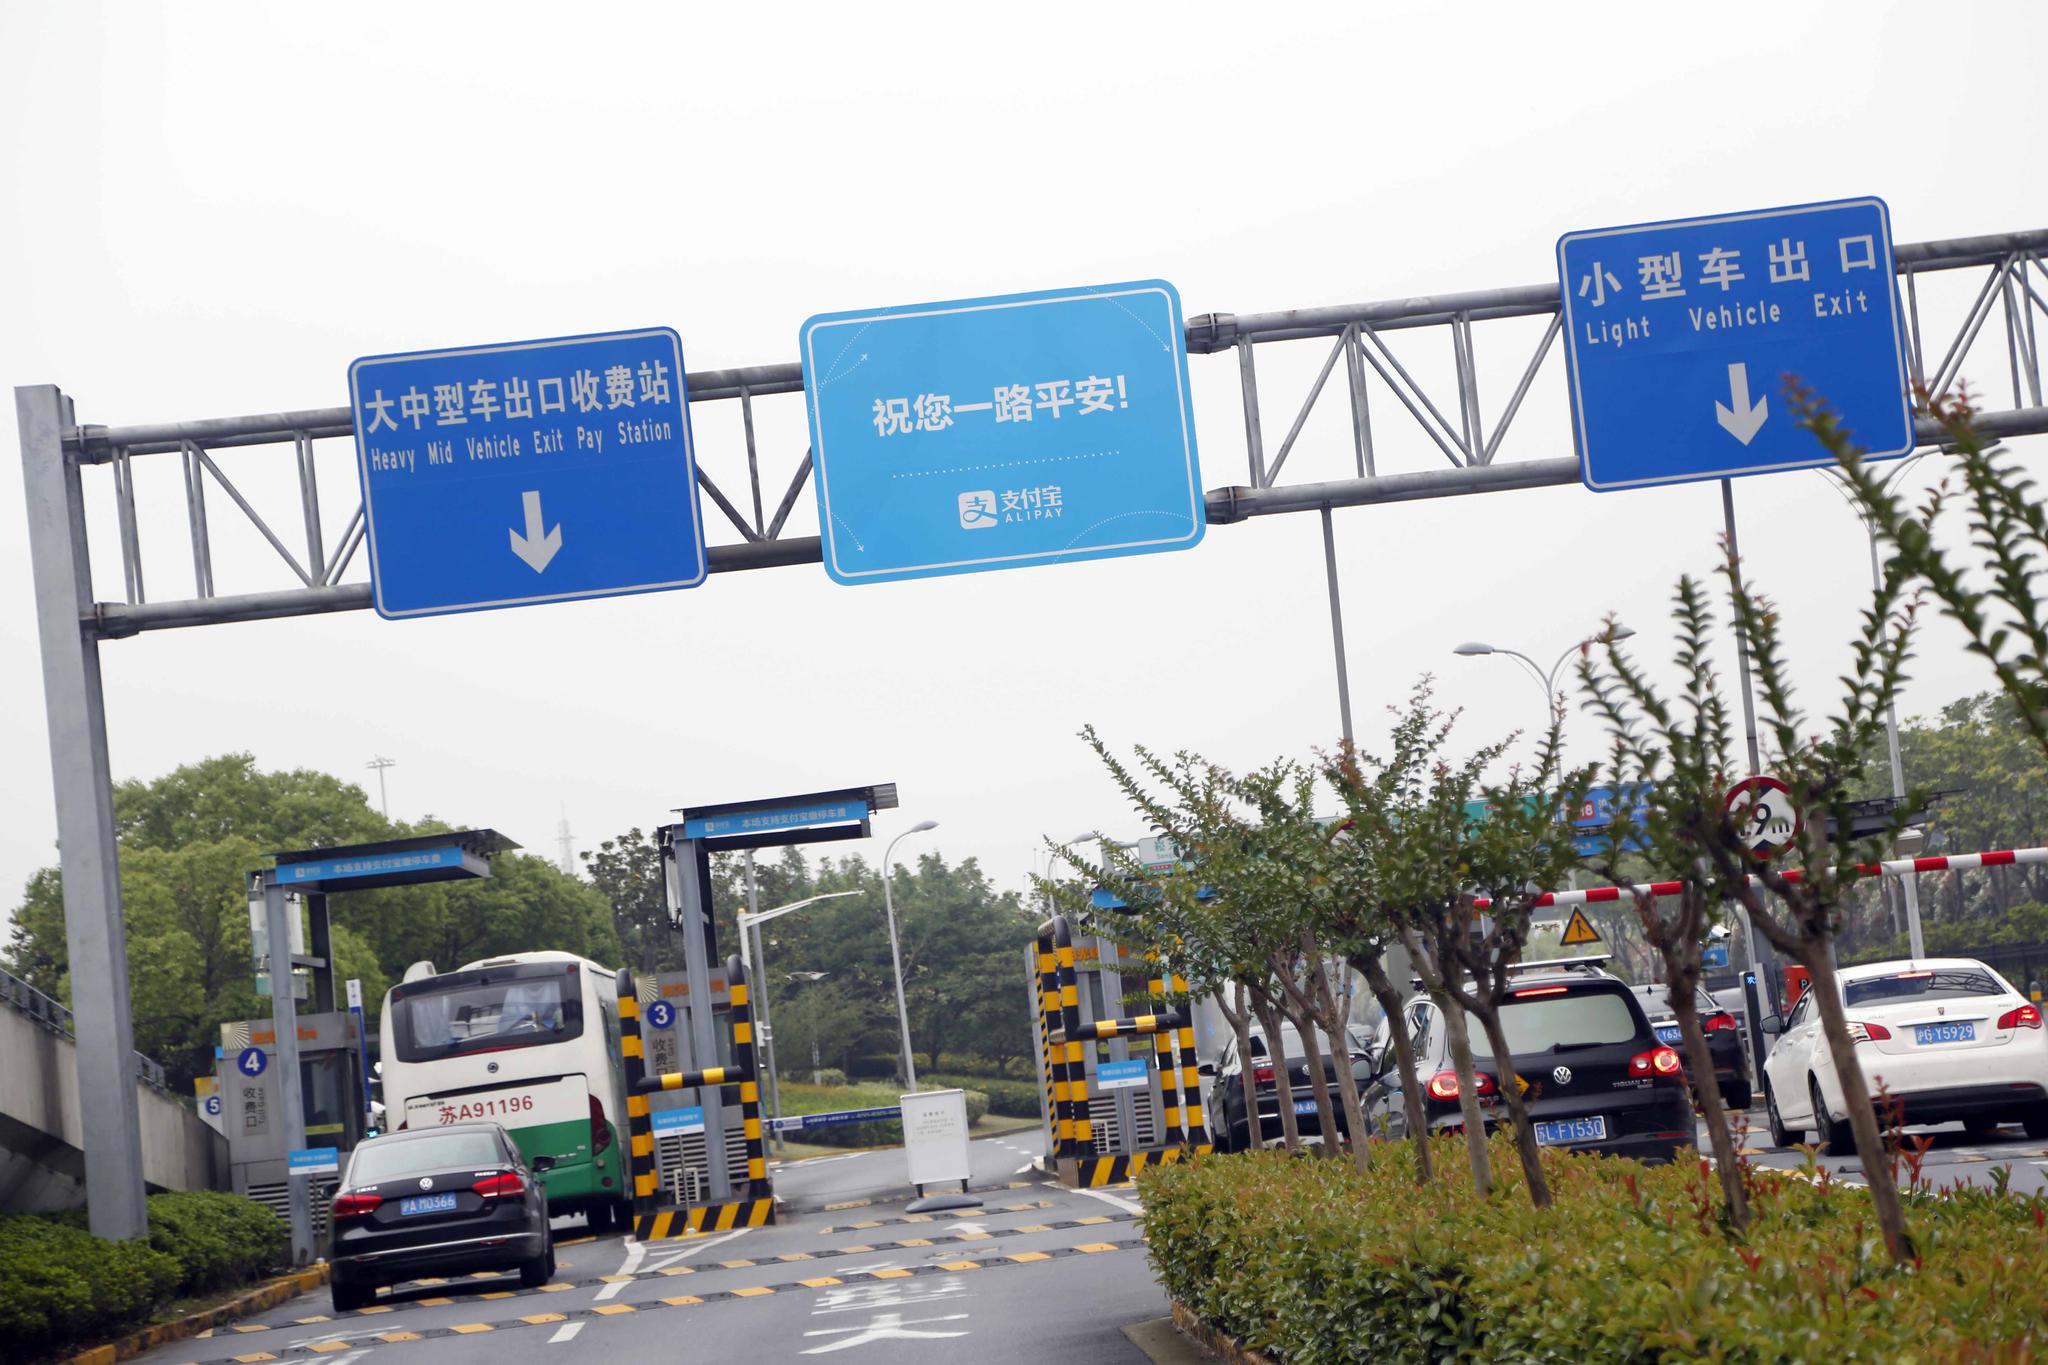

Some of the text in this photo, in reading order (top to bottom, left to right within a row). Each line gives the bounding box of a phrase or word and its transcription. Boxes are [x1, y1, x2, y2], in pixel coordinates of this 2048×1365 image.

[1578, 234, 1877, 307] 小型车出口
[1586, 289, 1868, 348] Light Vehicle Exit
[364, 359, 672, 435] 大中型车出口收费站
[872, 374, 1129, 438] 祝您一路平安!
[371, 417, 672, 473] Heavy Mid Vehicle Exit Pay Station
[1000, 485, 1063, 512] 支付宝
[1005, 508, 1062, 523] ALIPAY
[654, 1005, 669, 1025] 3
[244, 1052, 261, 1072] 4
[209, 1098, 221, 1114] 5
[438, 1095, 534, 1126] 苏A91196
